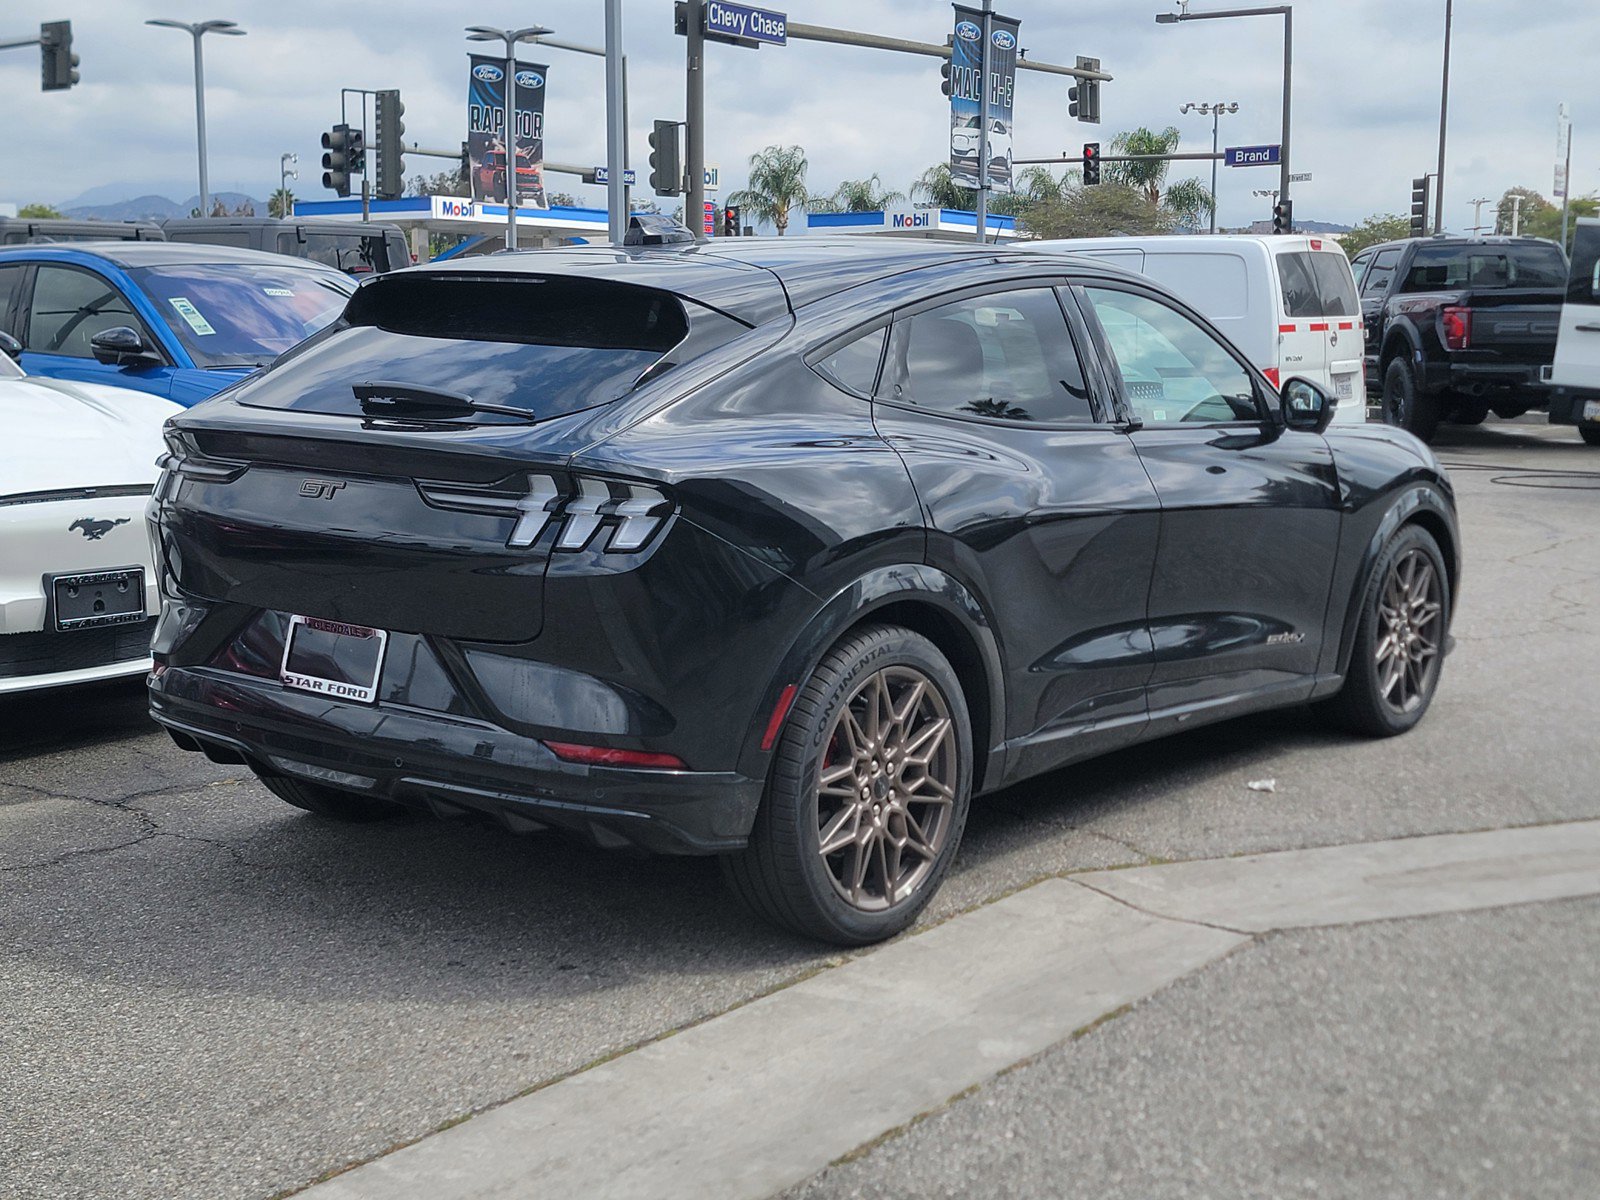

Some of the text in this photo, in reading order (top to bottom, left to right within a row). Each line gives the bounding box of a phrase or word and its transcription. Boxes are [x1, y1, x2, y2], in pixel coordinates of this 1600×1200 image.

[709, 3, 785, 37] Chevy Chase
[1235, 149, 1270, 162] Brand
[704, 168, 718, 185] bil
[442, 201, 475, 218] Mobil
[893, 213, 929, 228] Mobil
[299, 479, 347, 500] GT
[314, 621, 363, 637] GLENDALE
[284, 675, 369, 699] STAR FORD
[814, 644, 894, 748] CONTINENTAL
